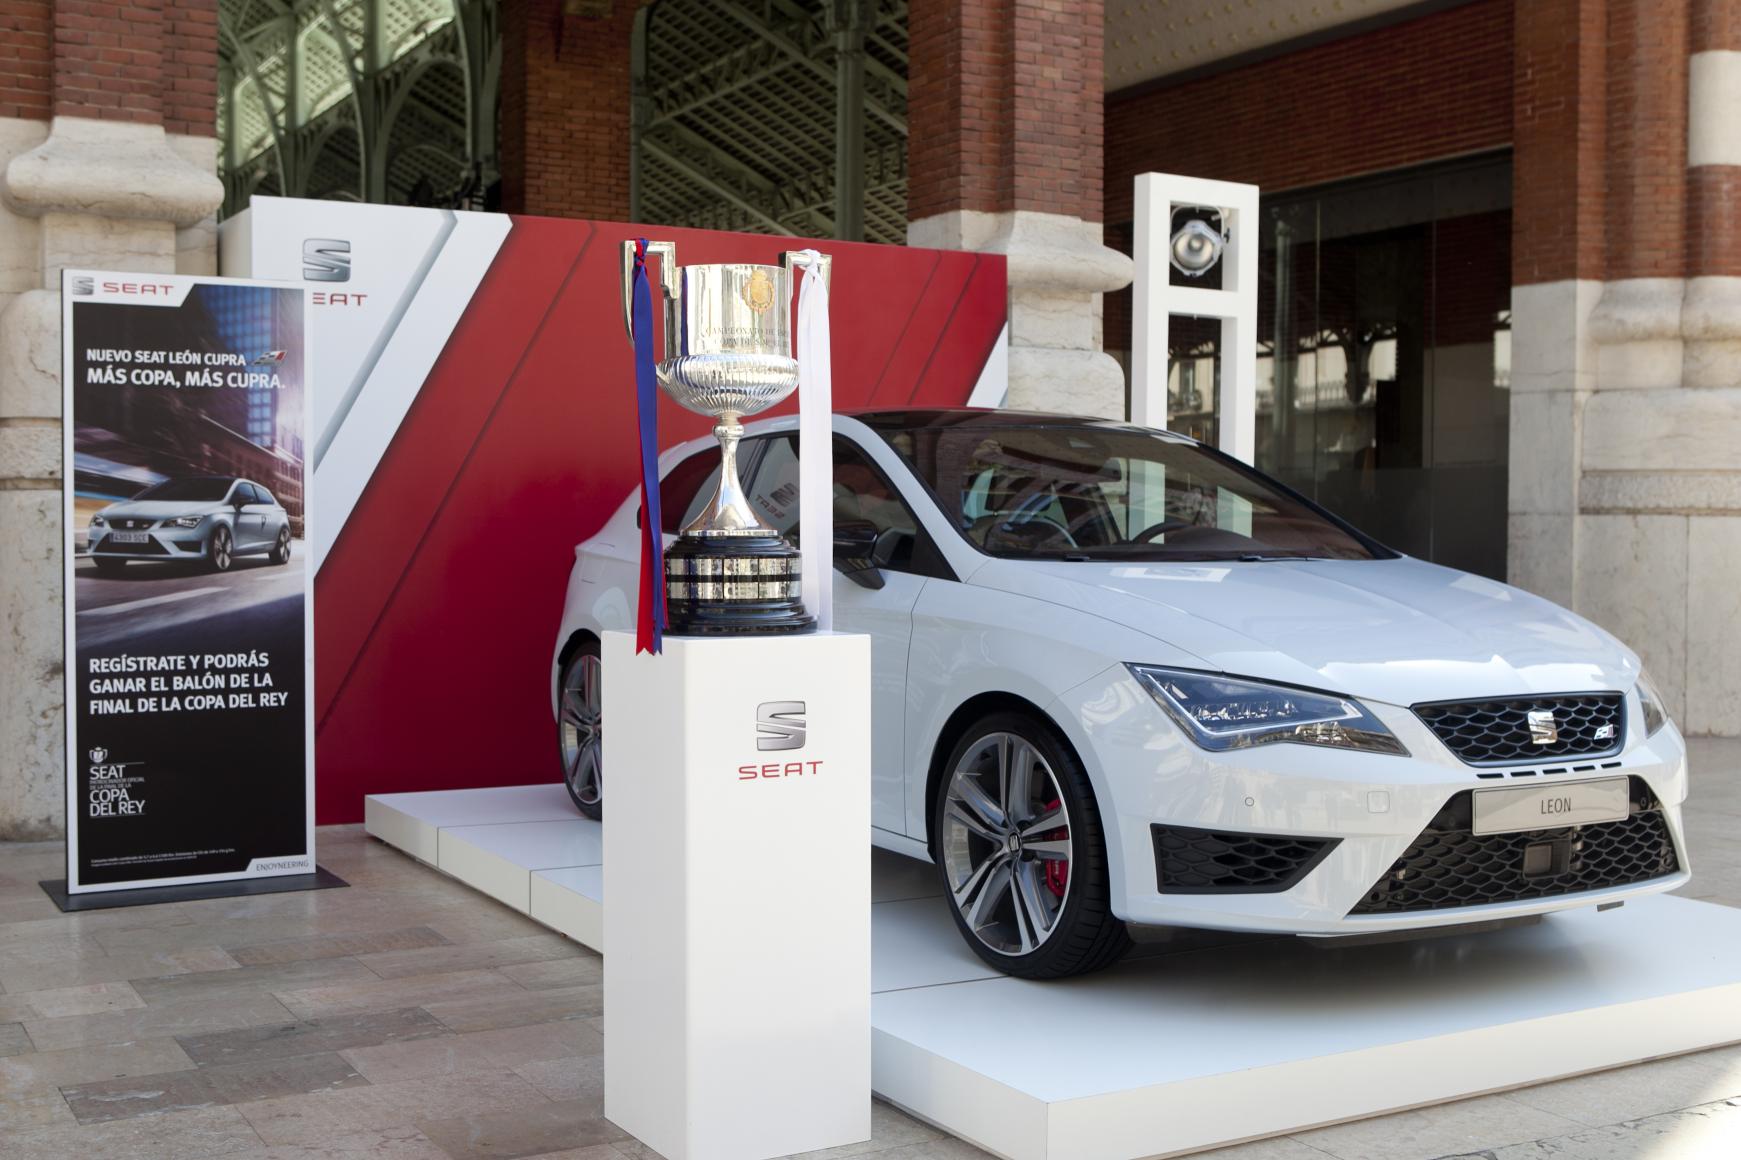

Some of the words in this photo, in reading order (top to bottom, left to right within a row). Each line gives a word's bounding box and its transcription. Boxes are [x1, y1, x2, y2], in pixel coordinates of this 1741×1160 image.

[103, 282, 174, 296] SEAT
[312, 292, 368, 306] EAT
[87, 348, 132, 362] NUEVO
[134, 350, 167, 364] SEAT
[168, 349, 202, 365] LEÓN
[204, 353, 247, 366] CUPRA
[87, 364, 127, 385] MÁS
[130, 369, 181, 389] COPA,
[185, 368, 223, 388] MÁS
[227, 371, 286, 389] CUPRA.
[89, 653, 187, 674] REGÍSTRATE
[189, 654, 201, 670] Y
[204, 649, 270, 669] PODRÁS
[89, 676, 147, 694] GANAR
[150, 676, 169, 692] EL
[172, 671, 225, 692] BALÓN
[230, 673, 250, 689] DE
[253, 672, 274, 688] LA
[89, 698, 134, 715] FINAL
[137, 697, 159, 713] DE
[161, 696, 182, 712] LA
[184, 694, 226, 711] COPA
[228, 693, 257, 709] DEL
[259, 691, 289, 708] REY
[89, 764, 126, 781] SEAT
[738, 760, 824, 781] SEAT
[89, 788, 130, 804] COPA
[89, 802, 117, 817] DEL
[118, 799, 146, 816] REY
[1541, 797, 1573, 815] LEON
